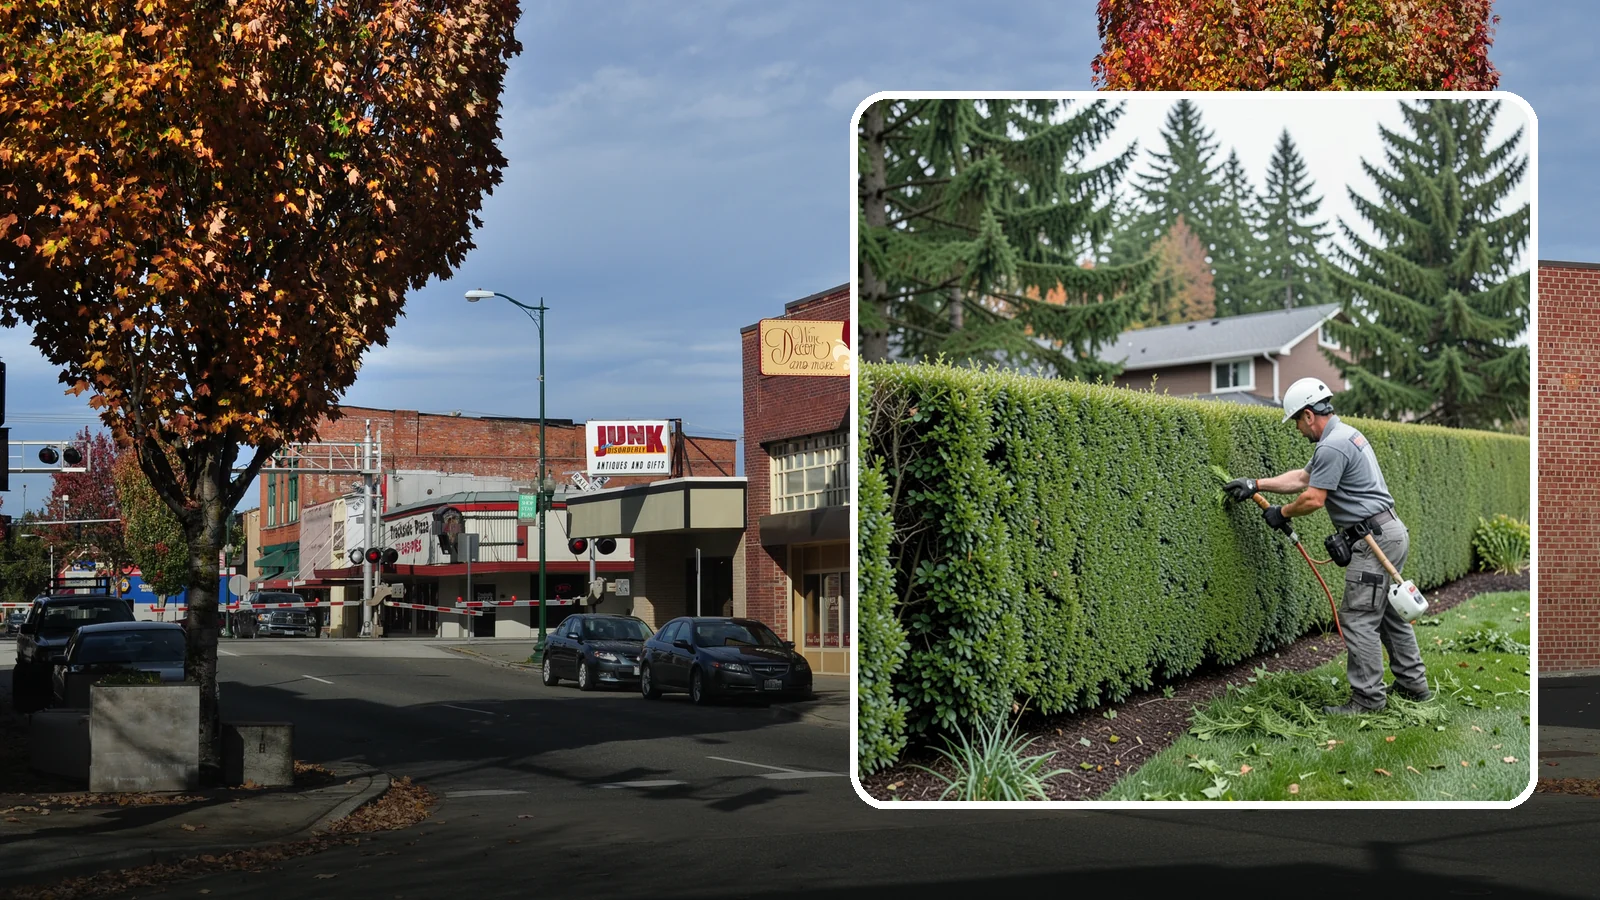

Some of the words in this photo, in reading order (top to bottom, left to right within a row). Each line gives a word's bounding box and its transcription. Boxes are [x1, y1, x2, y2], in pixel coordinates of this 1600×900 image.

[765, 327, 831, 365] Decor
[595, 425, 664, 457] JUNK
[607, 446, 646, 454] DISORDERLY
[596, 461, 628, 470] ANTIQUES
[631, 461, 644, 470] AND
[646, 460, 665, 469] GIFTS
[414, 519, 429, 535] Pizza
